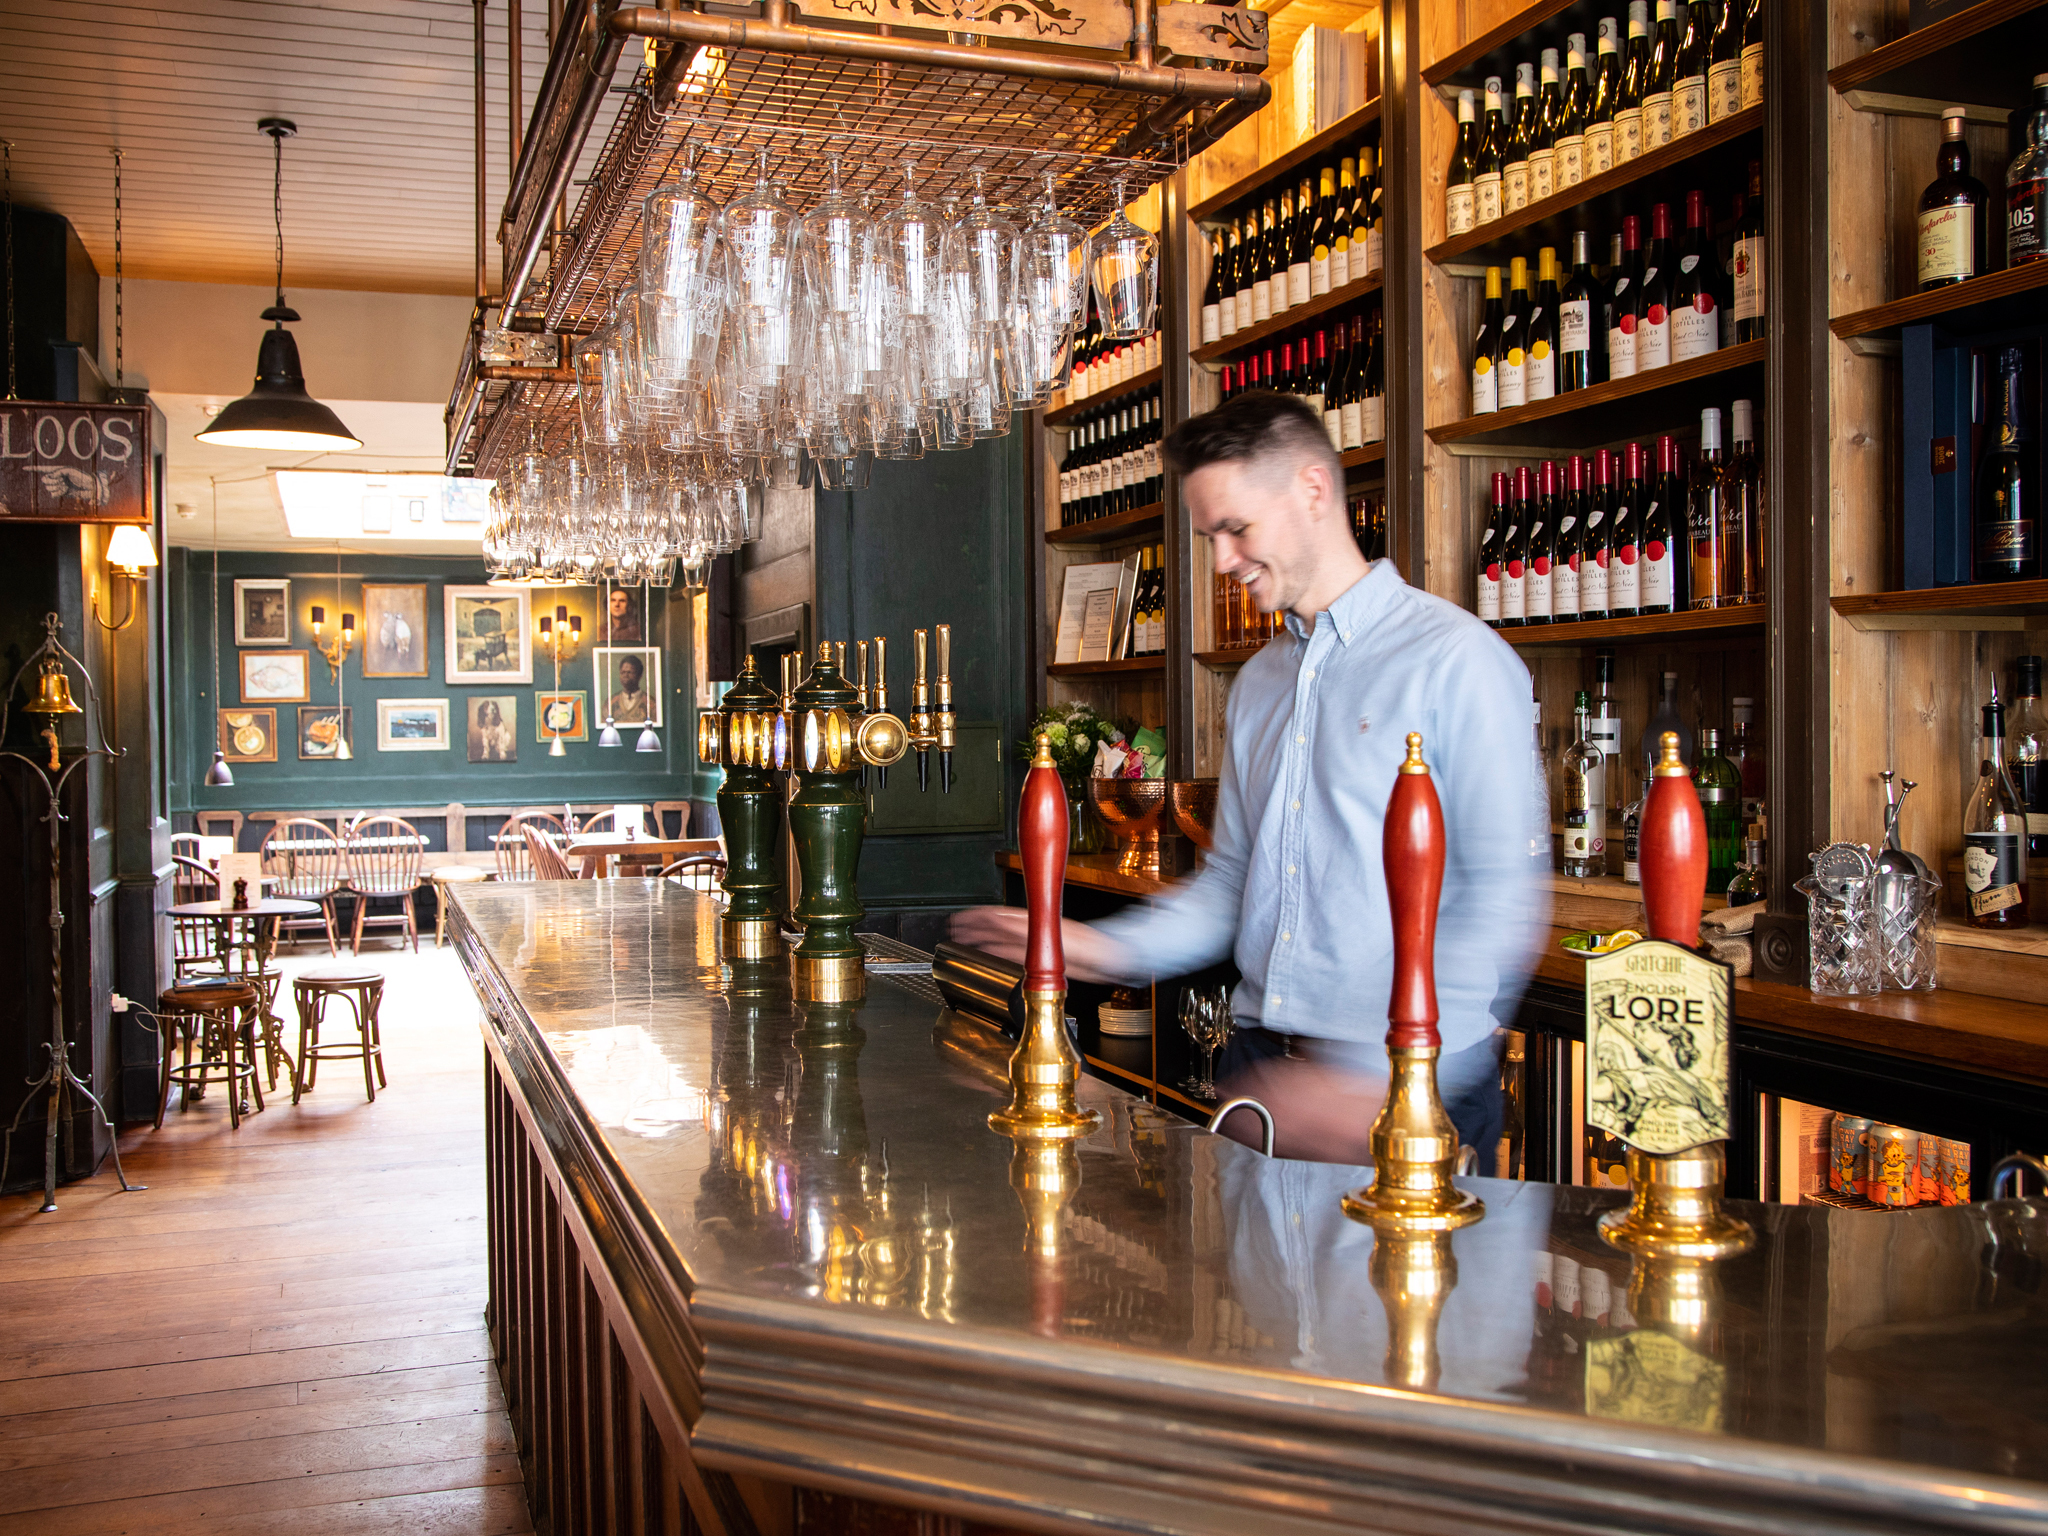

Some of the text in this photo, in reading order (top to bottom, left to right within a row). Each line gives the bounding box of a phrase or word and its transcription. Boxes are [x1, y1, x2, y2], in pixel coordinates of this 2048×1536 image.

[2008, 205, 2035, 230] 105
[1924, 247, 1936, 257] 30
[1673, 318, 1706, 329] COTILLES
[0, 412, 134, 462] LOOS
[1993, 529, 2030, 547] Roger
[1627, 983, 1687, 996] ENGLISH
[1610, 994, 1704, 1026] LORE
